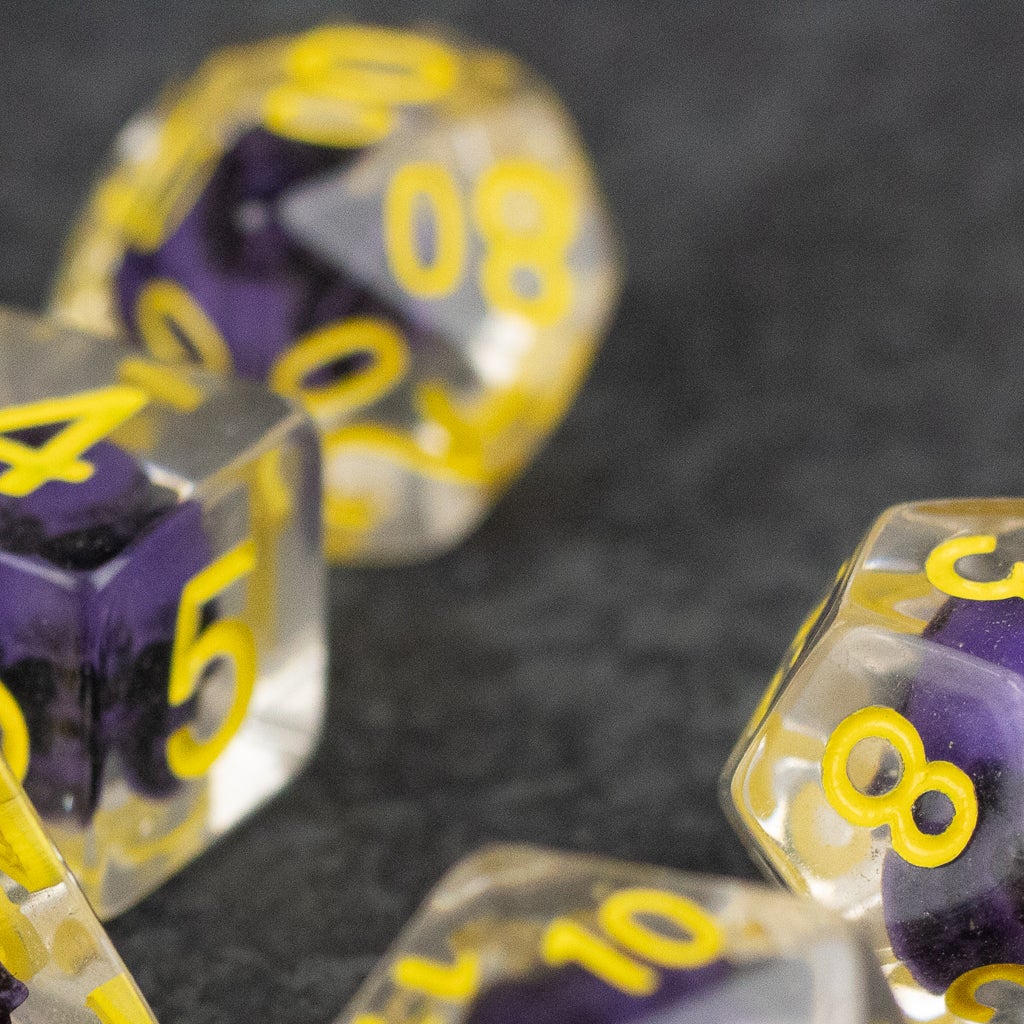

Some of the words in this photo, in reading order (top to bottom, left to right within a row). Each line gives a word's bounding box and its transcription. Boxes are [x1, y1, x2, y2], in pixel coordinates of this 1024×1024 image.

[166, 540, 257, 778] 5
[822, 705, 978, 868] 8
[542, 889, 726, 996] 10
